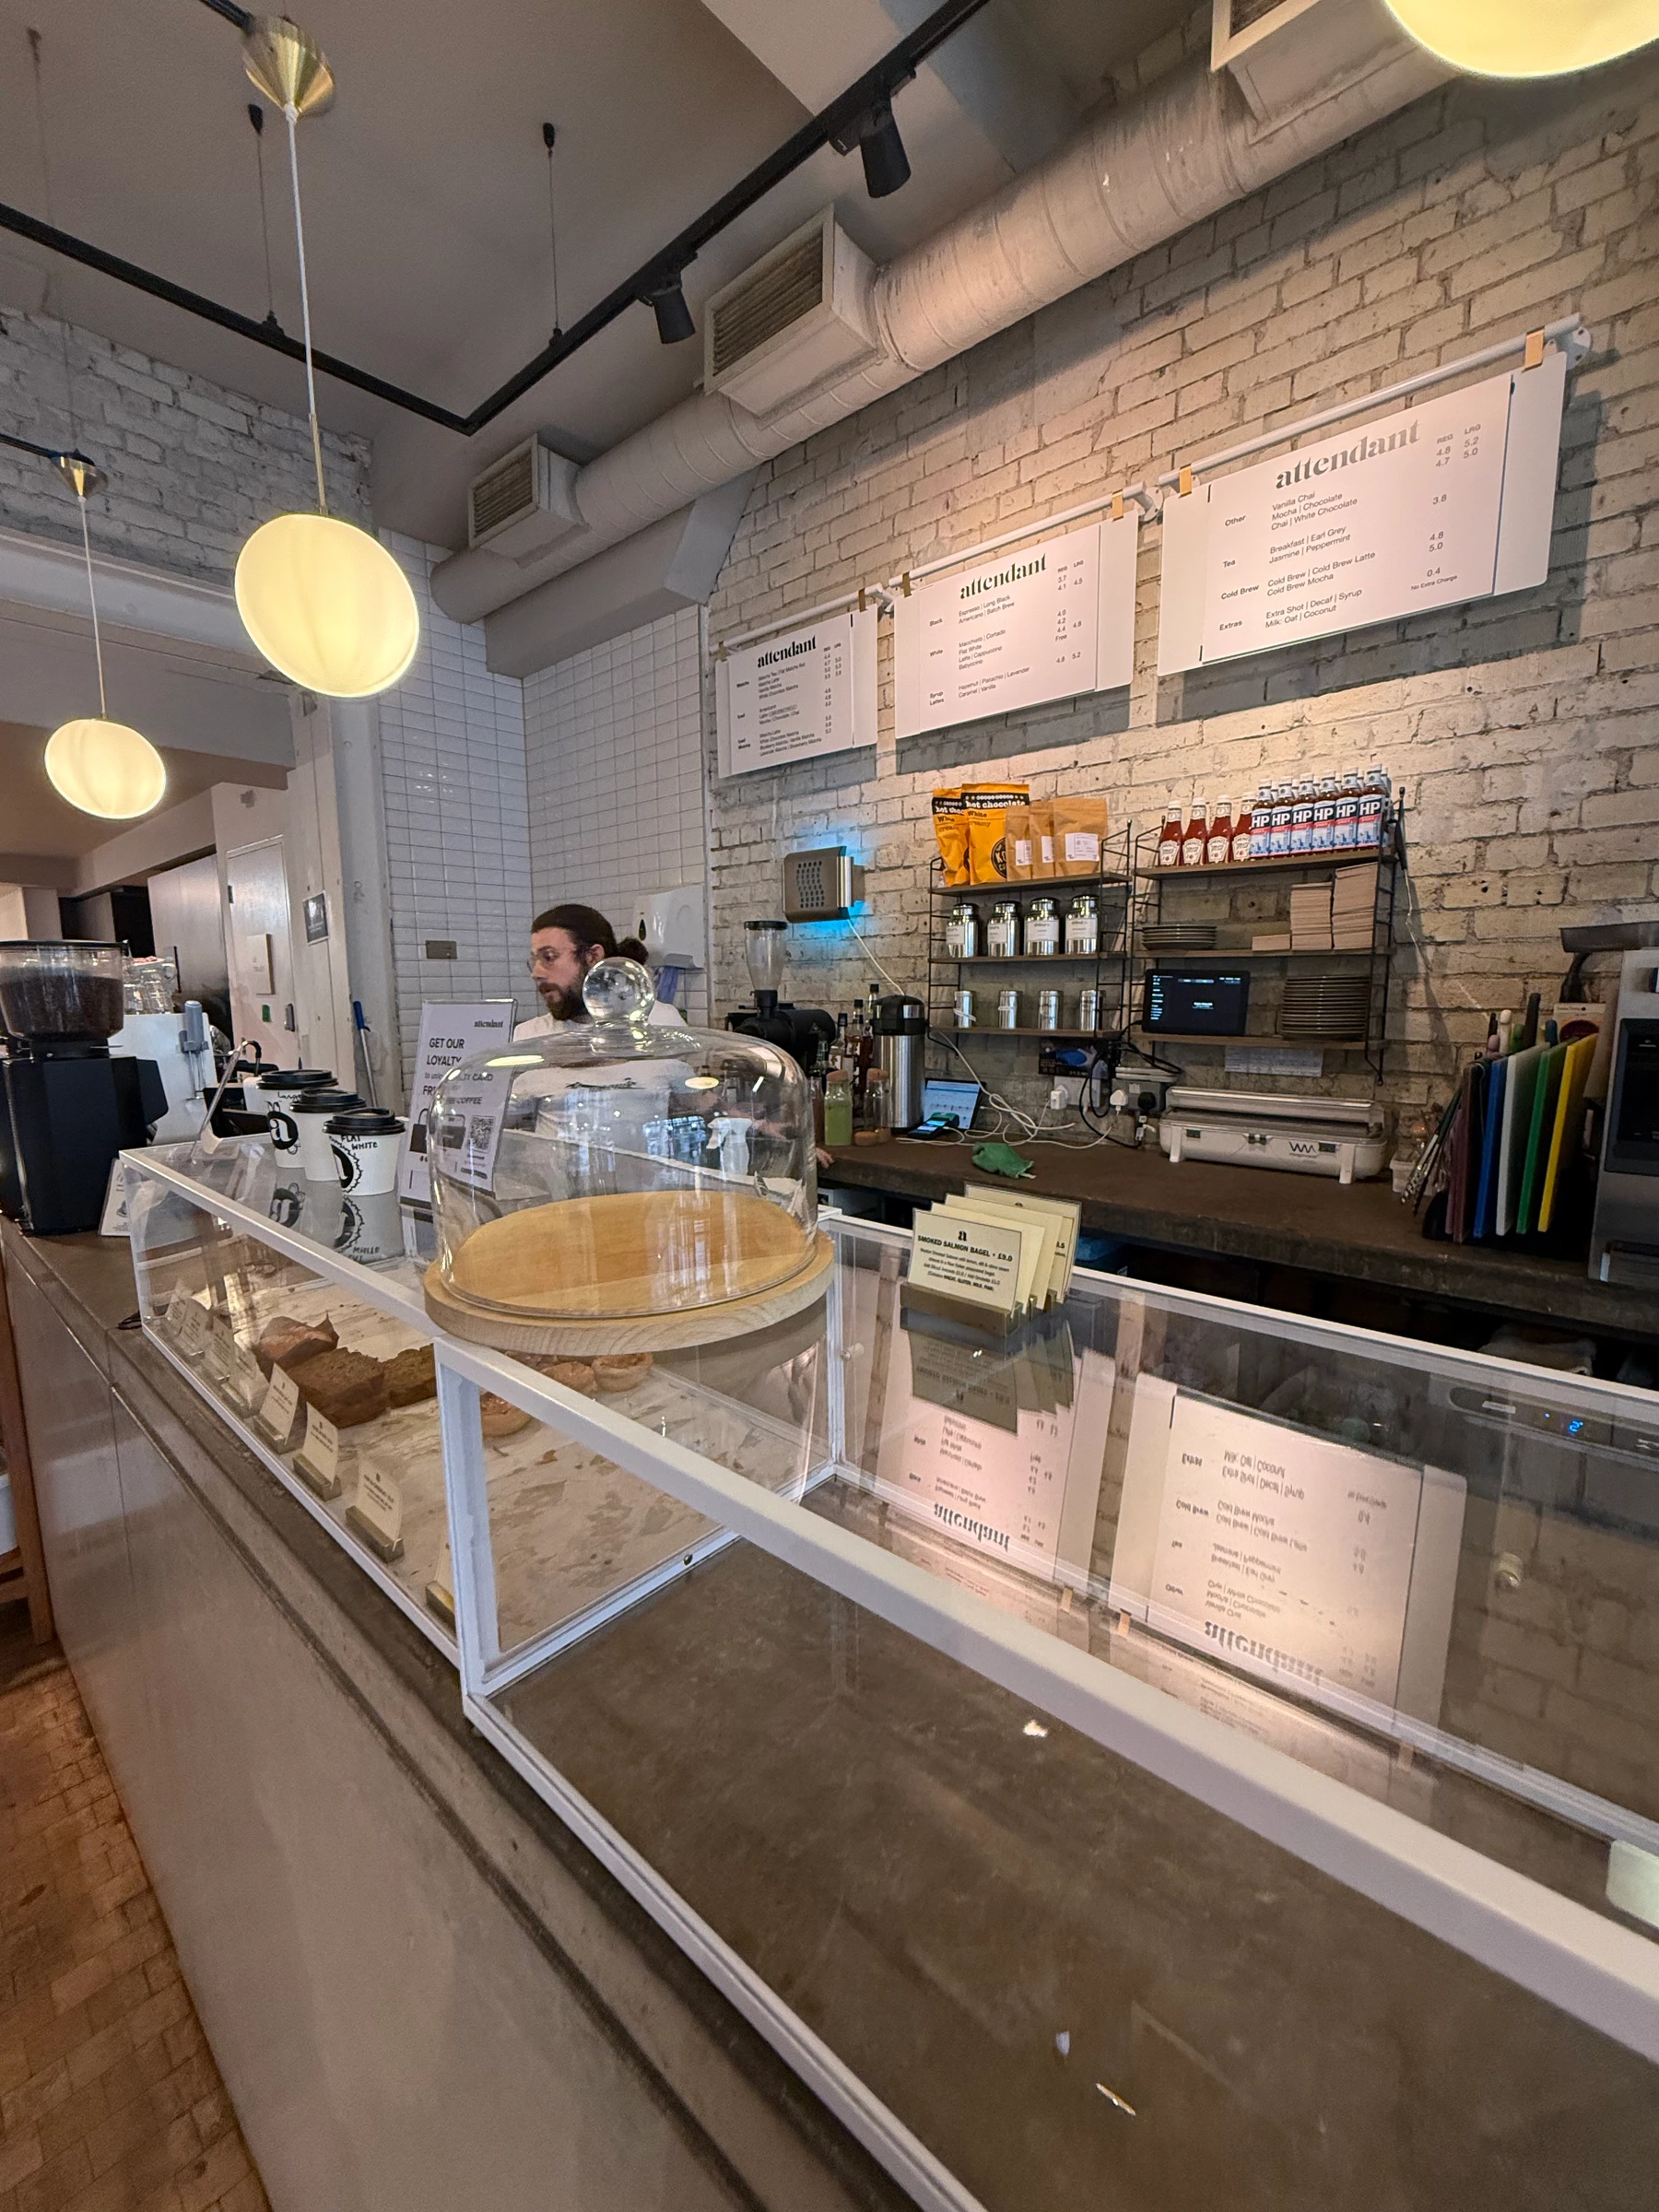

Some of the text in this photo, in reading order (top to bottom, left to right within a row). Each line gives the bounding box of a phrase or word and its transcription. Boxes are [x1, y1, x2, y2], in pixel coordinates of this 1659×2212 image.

[1437, 424, 1481, 444] REG LRG
[1276, 419, 1420, 488] attendant
[1436, 437, 1479, 456] 4.8 5.2
[1435, 447, 1477, 466] 4.7 5.0
[1272, 491, 1315, 512] Vanilla Chai
[1432, 494, 1447, 504] 3.8
[1272, 493, 1343, 521] Mocha Chocolate
[1224, 515, 1246, 526] Other
[1271, 498, 1358, 531] Chai White Chocolate
[1270, 526, 1347, 554] Breakfast Earl Grey
[1430, 531, 1443, 540] 4.8
[1268, 534, 1351, 564] Jasmine Peppermint
[1430, 542, 1443, 552] 5.0
[1223, 559, 1236, 568] Tea
[1267, 552, 1375, 587] Cold Brew Cold Brew Latte
[959, 552, 1048, 600] attendant
[1058, 575, 1066, 583] 3.7
[1427, 567, 1441, 577] 0.4
[1437, 575, 1457, 583] Charge
[1267, 573, 1334, 596] Cold Brew Mocha
[1220, 584, 1259, 600] Cold Brew
[959, 606, 980, 617] Espresso
[983, 600, 995, 608] Long
[1266, 589, 1362, 619] Extra Shot Decaf Syrup
[959, 612, 983, 624] Americano
[986, 606, 1001, 615] Batch
[1265, 605, 1336, 629] Milk: Oat Coconut
[930, 618, 943, 627] Black
[1219, 620, 1242, 631] Extras
[959, 629, 1006, 648] Macchiato Cortado
[757, 635, 817, 668] attendant
[930, 649, 943, 657] White
[969, 644, 982, 653] White
[973, 646, 1003, 658] Cappuccino
[1072, 652, 1081, 660] 5.2
[959, 659, 983, 670] Babyccino
[959, 667, 1030, 690] Hazelnut Pistachio Lavender
[959, 684, 996, 699] Caramel Vanilla
[1313, 807, 1334, 821] HP
[1336, 804, 1356, 818] HP
[1359, 802, 1381, 816] HP
[1252, 815, 1269, 828] HP
[1272, 813, 1290, 826] HP
[1293, 810, 1312, 823] HP
[429, 1038, 465, 1049] GET OUR
[427, 1055, 462, 1066] LOYALTY
[423, 1086, 436, 1096] FR
[918, 1235, 942, 1245] SMOKED
[943, 1241, 968, 1252] SALMON
[971, 1246, 990, 1257] BAGEL
[997, 1253, 1013, 1262] £9.0
